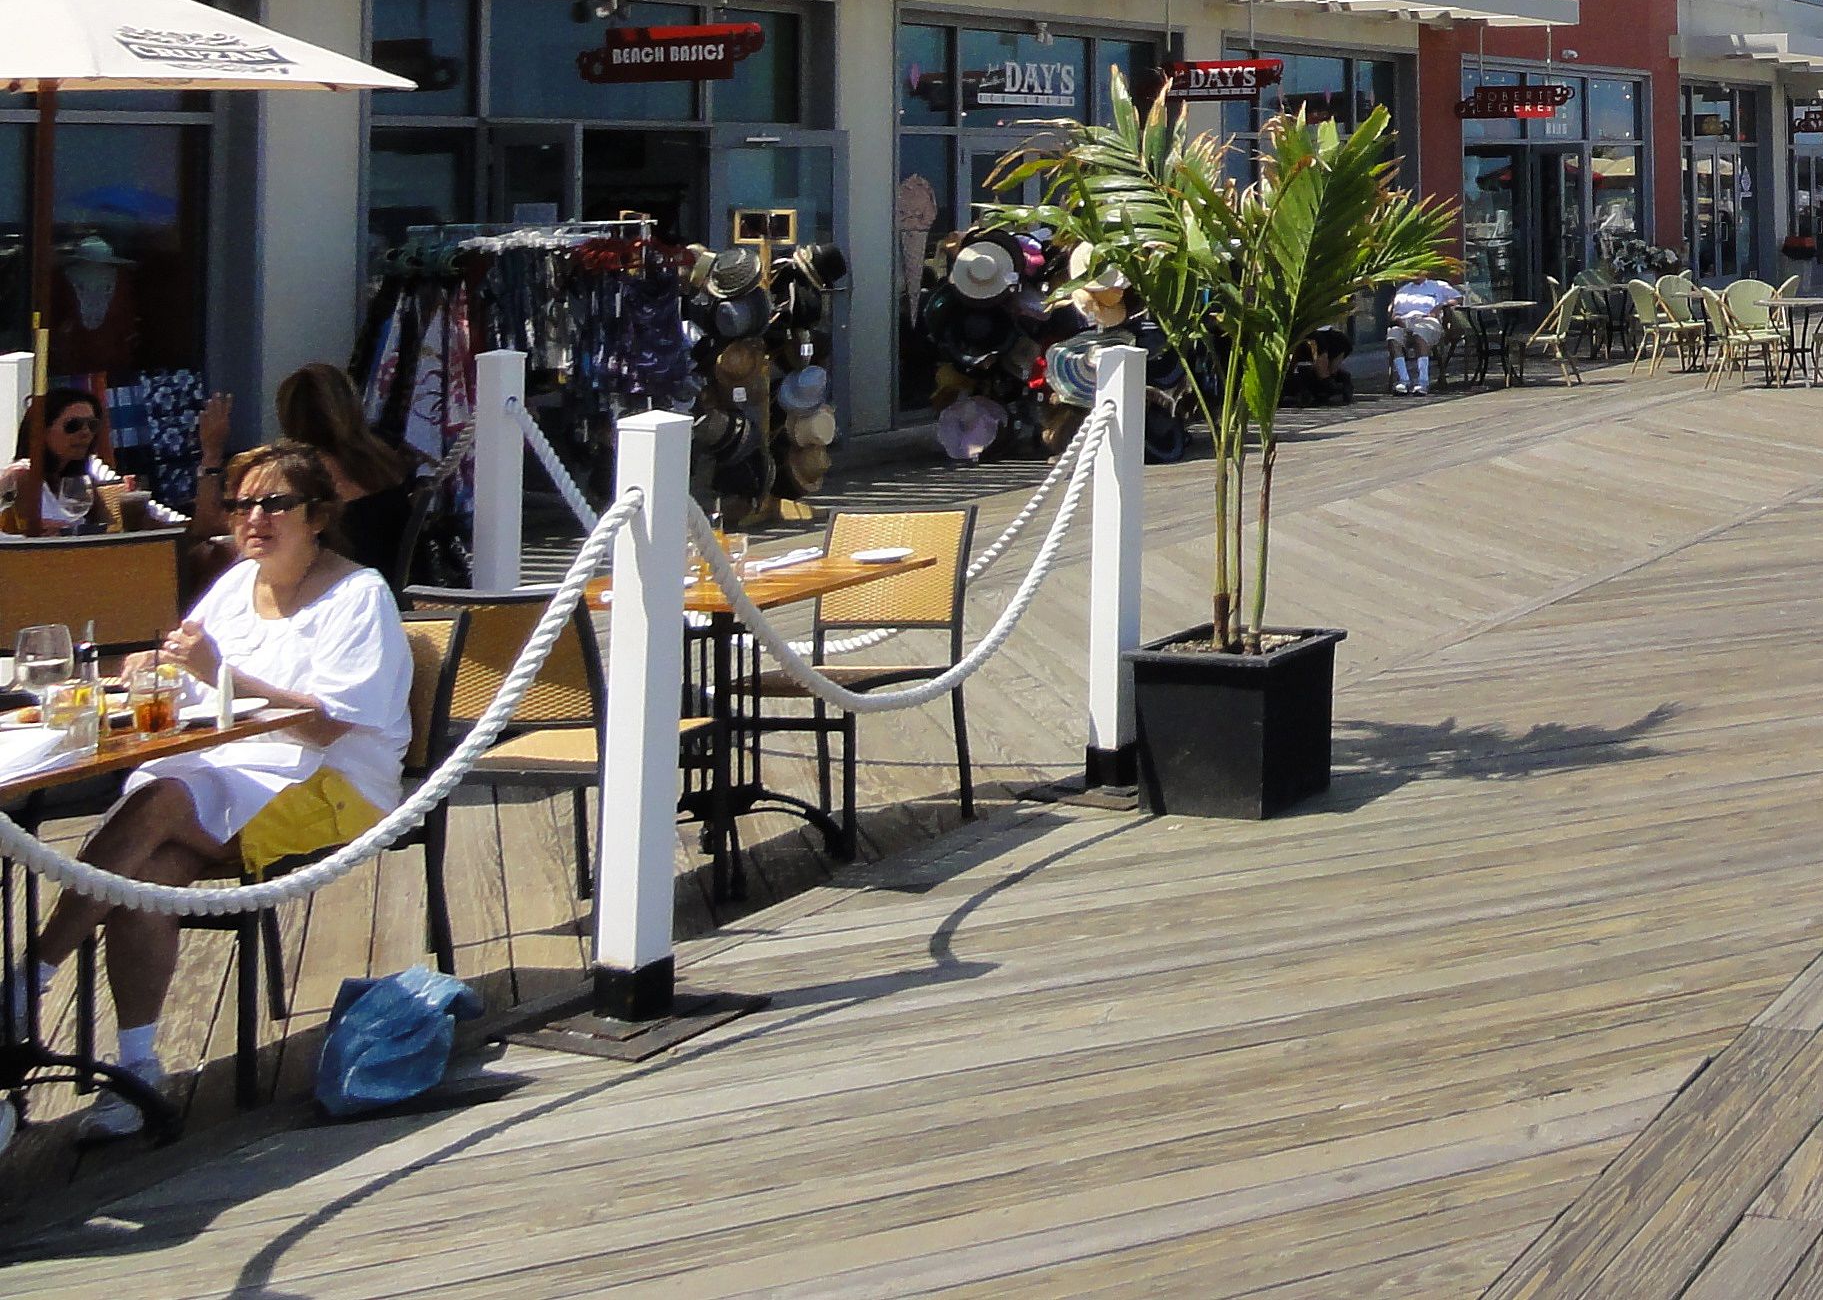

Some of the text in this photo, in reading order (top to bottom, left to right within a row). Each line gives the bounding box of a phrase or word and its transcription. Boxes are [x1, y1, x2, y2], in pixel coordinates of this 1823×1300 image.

[130, 44, 277, 62] CRUZAN
[612, 43, 725, 64] BEACH BASICS
[1004, 60, 1075, 95] DAY'S
[1189, 66, 1257, 88] DAY'S
